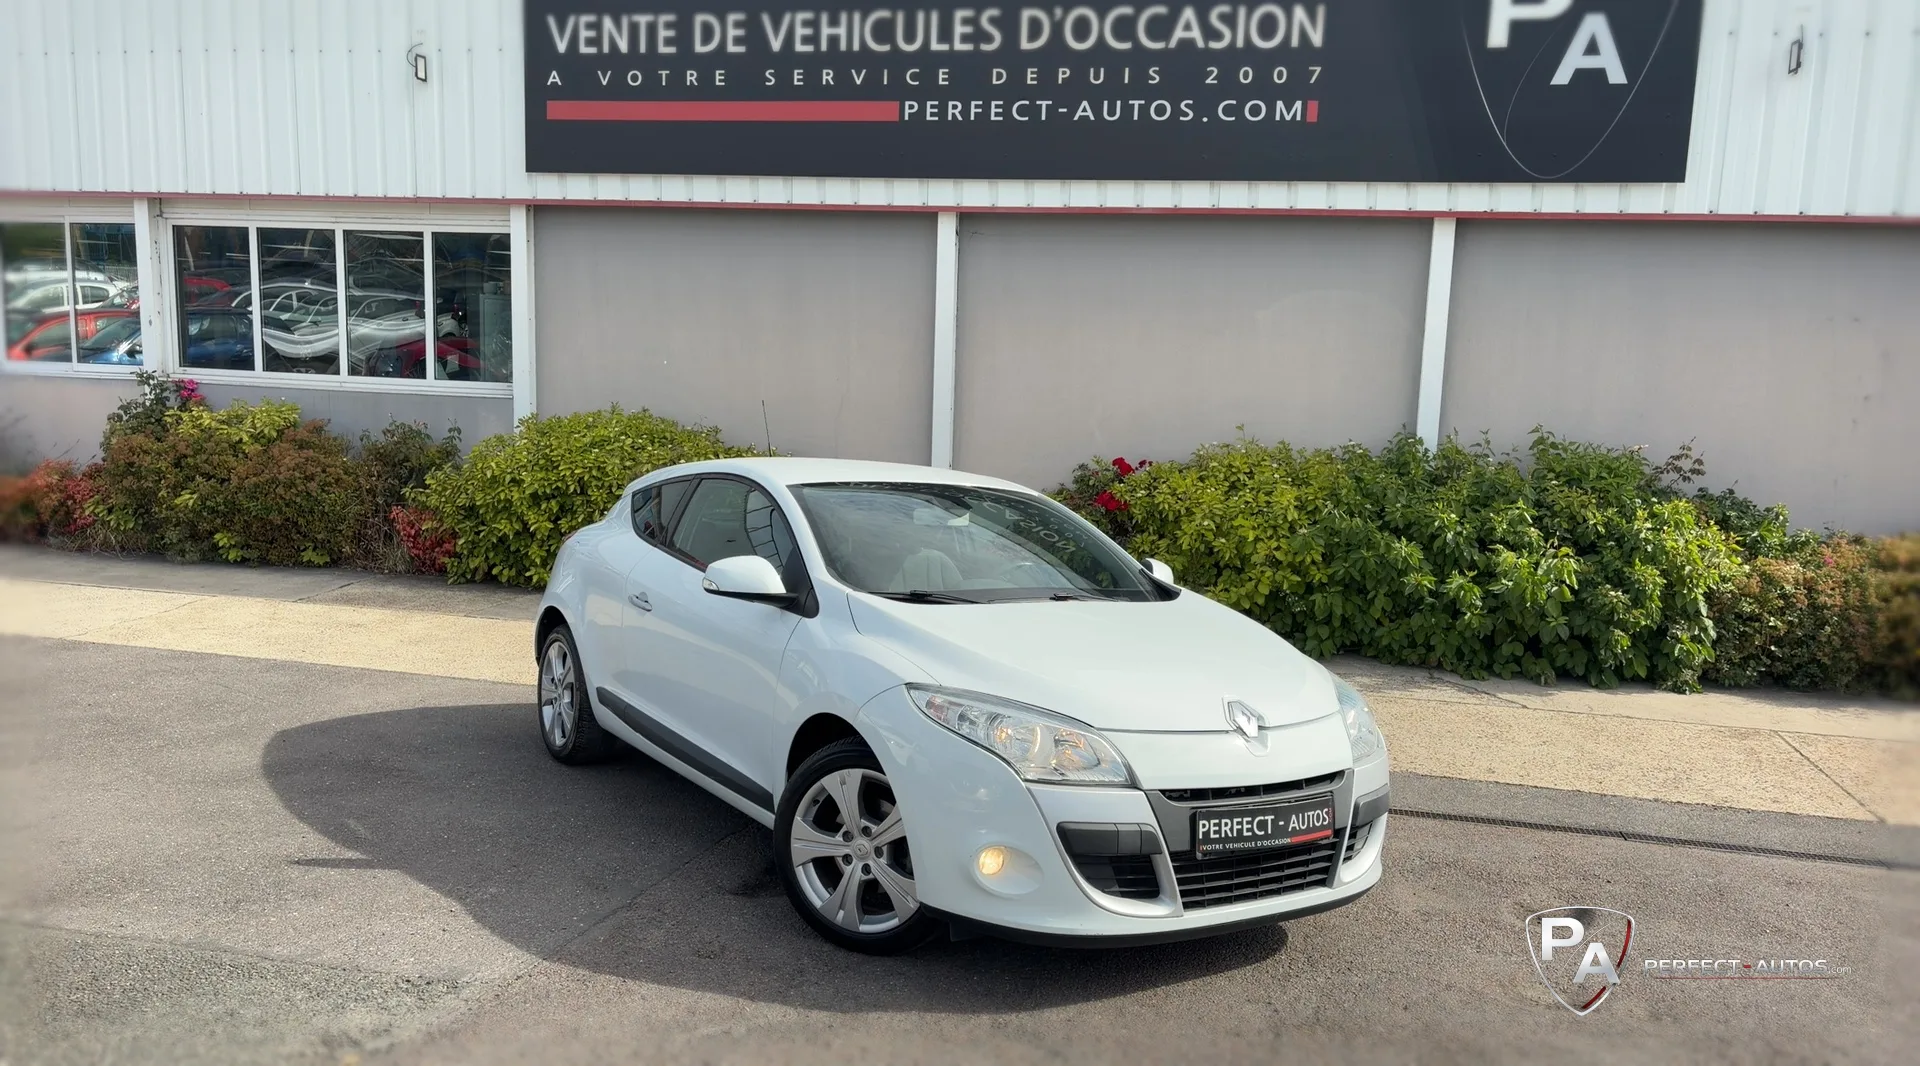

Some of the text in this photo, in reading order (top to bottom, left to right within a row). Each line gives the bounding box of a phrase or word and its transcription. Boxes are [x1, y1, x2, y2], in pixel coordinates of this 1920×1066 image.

[546, 4, 1326, 54] VENTE DE VEHICULES D'OCCASION
[547, 66, 1322, 86] A VOTRE SERVICE DEPUIS 2007
[903, 99, 1303, 122] PERFECT-AUTOS.COM
[1198, 815, 1275, 839] PERFECT
[1288, 808, 1329, 831] AUTOS
[1225, 841, 1255, 849] VEHICULE
